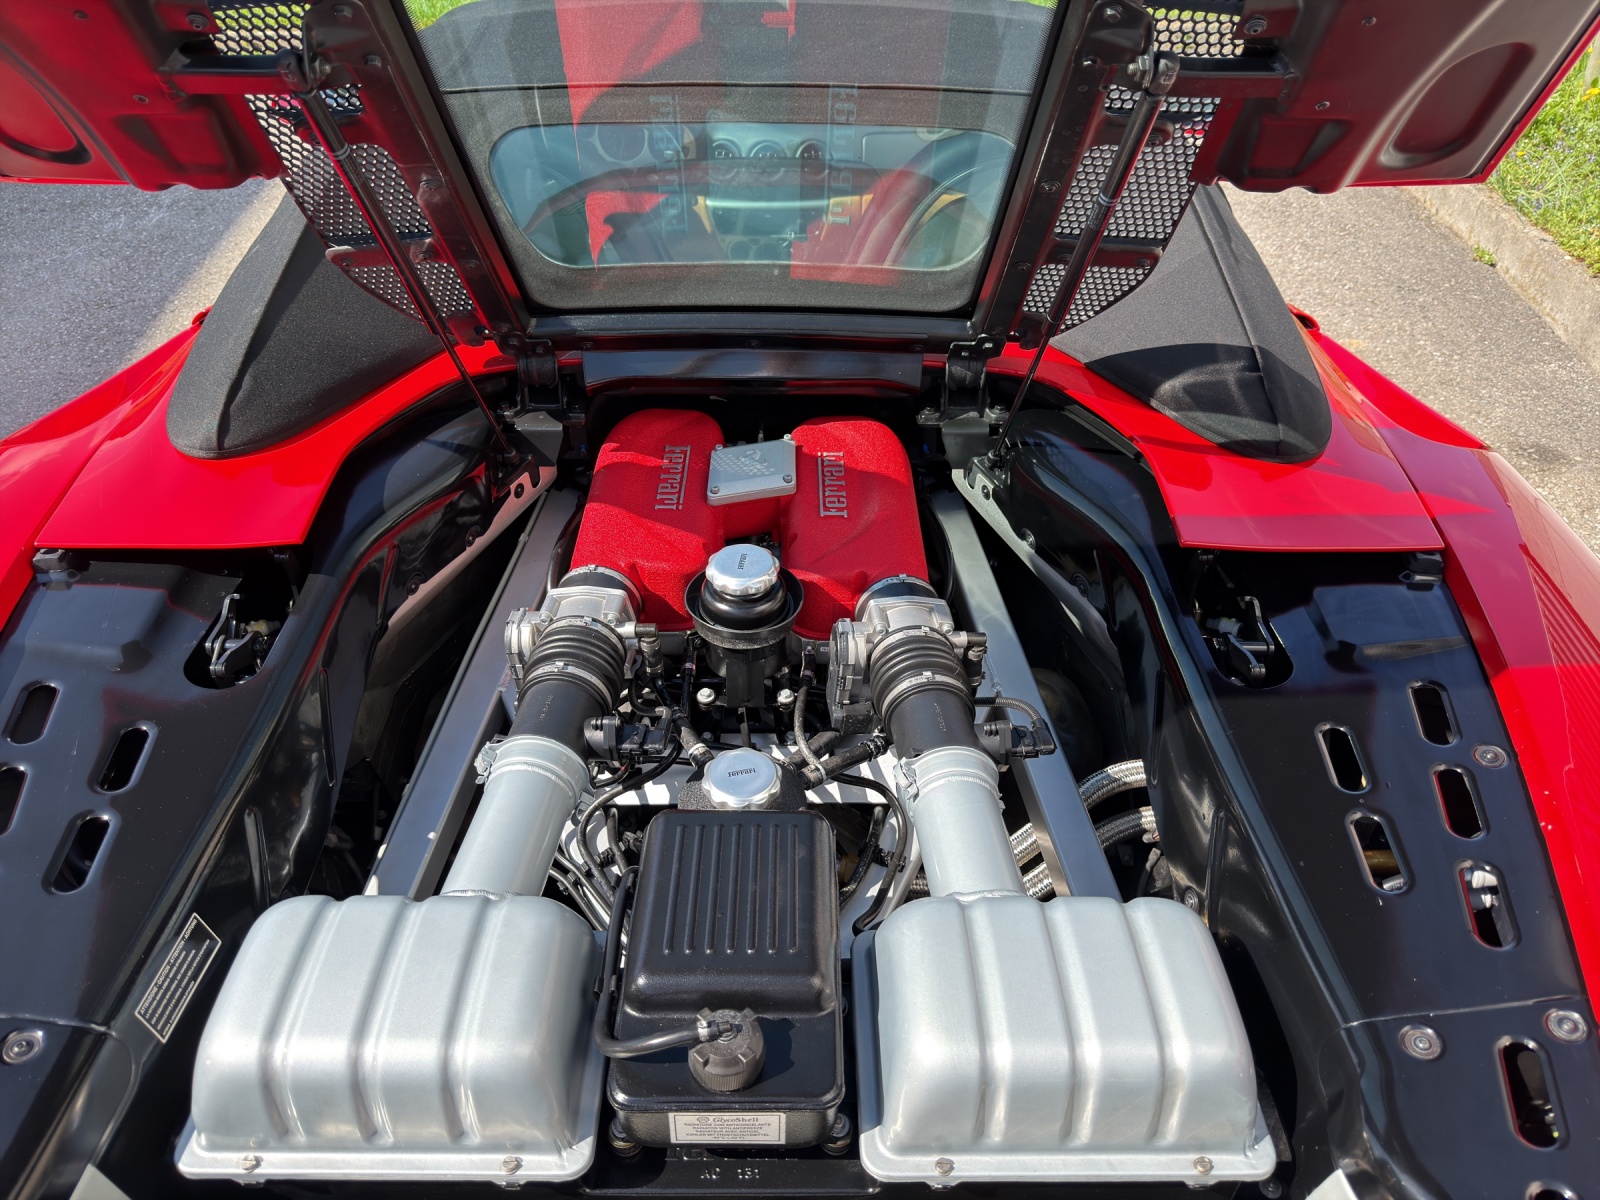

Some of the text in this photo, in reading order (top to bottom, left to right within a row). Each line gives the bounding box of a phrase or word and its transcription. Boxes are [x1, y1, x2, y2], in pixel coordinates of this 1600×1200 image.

[654, 444, 690, 511] Ferrari
[817, 451, 848, 518] Ferrari
[737, 553, 748, 570] Ferrari
[728, 768, 756, 778] Ferrari
[140, 986, 158, 1015] ATTENZIONE
[158, 965, 170, 985] CAUTION
[170, 940, 185, 964] ATTENTION
[184, 919, 197, 939] ACHTUNG
